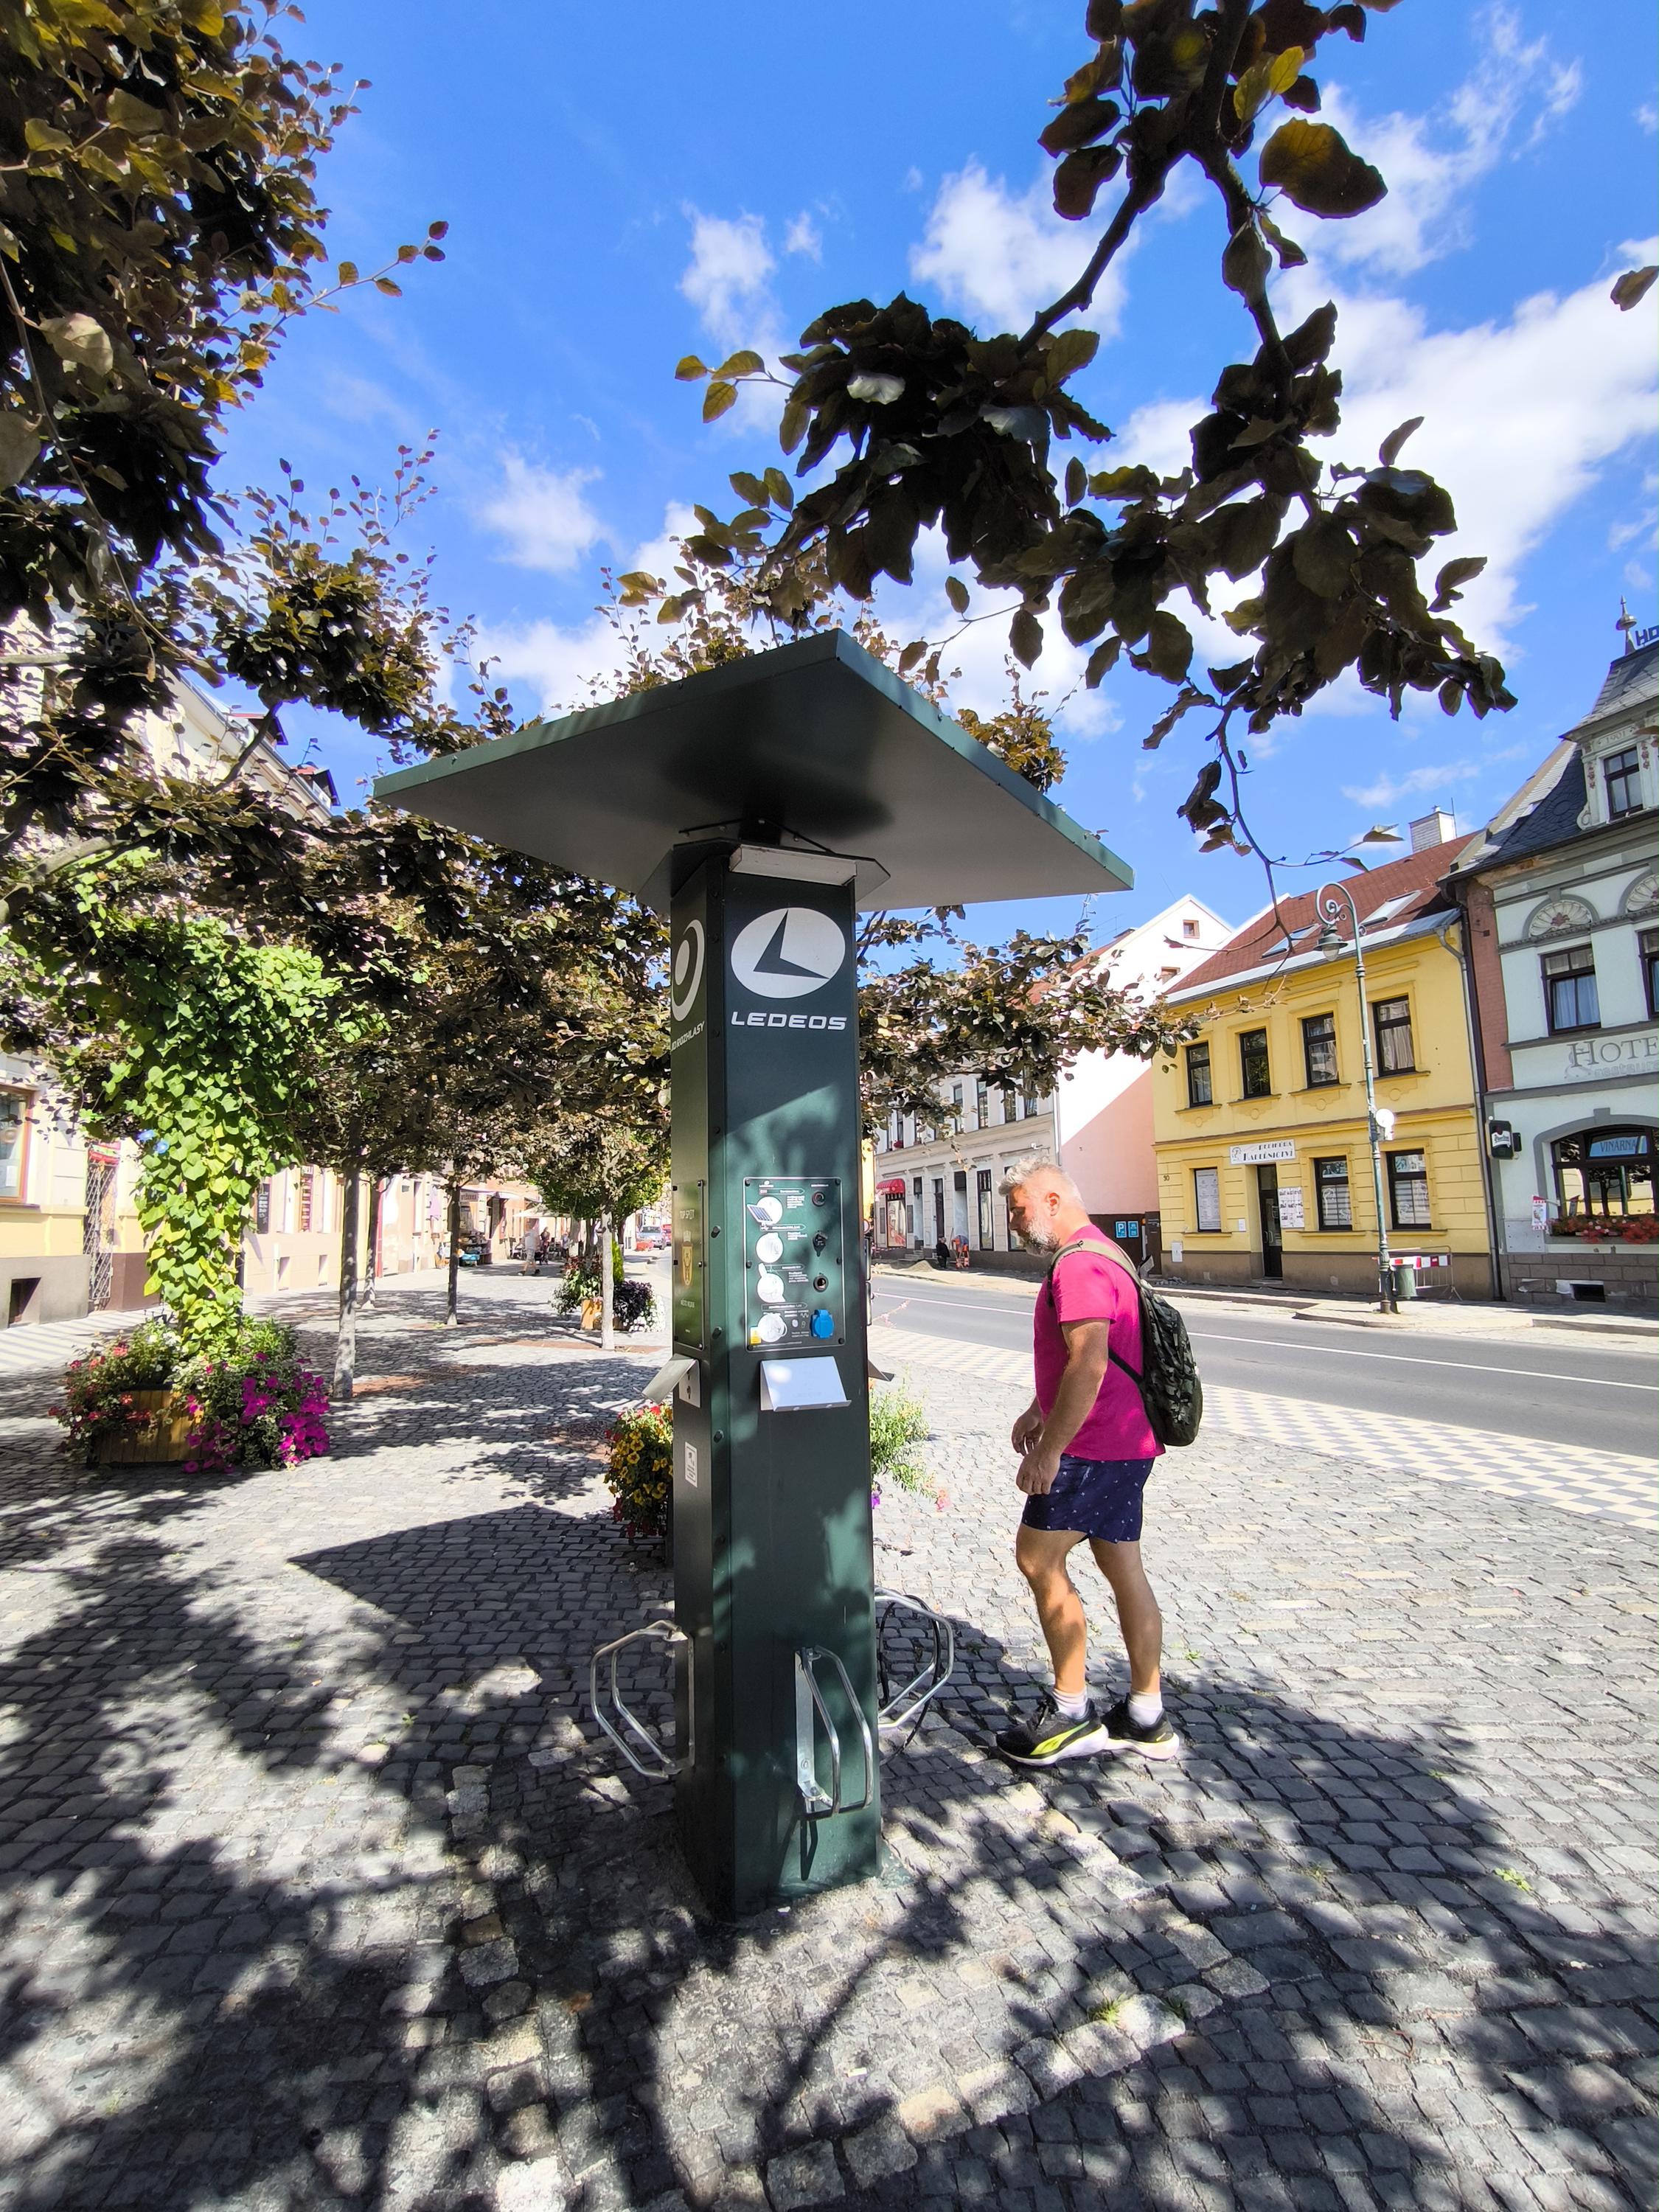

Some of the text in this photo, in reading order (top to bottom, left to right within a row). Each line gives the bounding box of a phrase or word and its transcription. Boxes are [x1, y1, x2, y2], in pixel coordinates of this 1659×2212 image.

[731, 1011, 847, 1031] LEDEOS
[677, 1020, 705, 1048] ROZHLASY
[1566, 1035, 1659, 1068] HOTE
[1118, 1223, 1124, 1233] P
